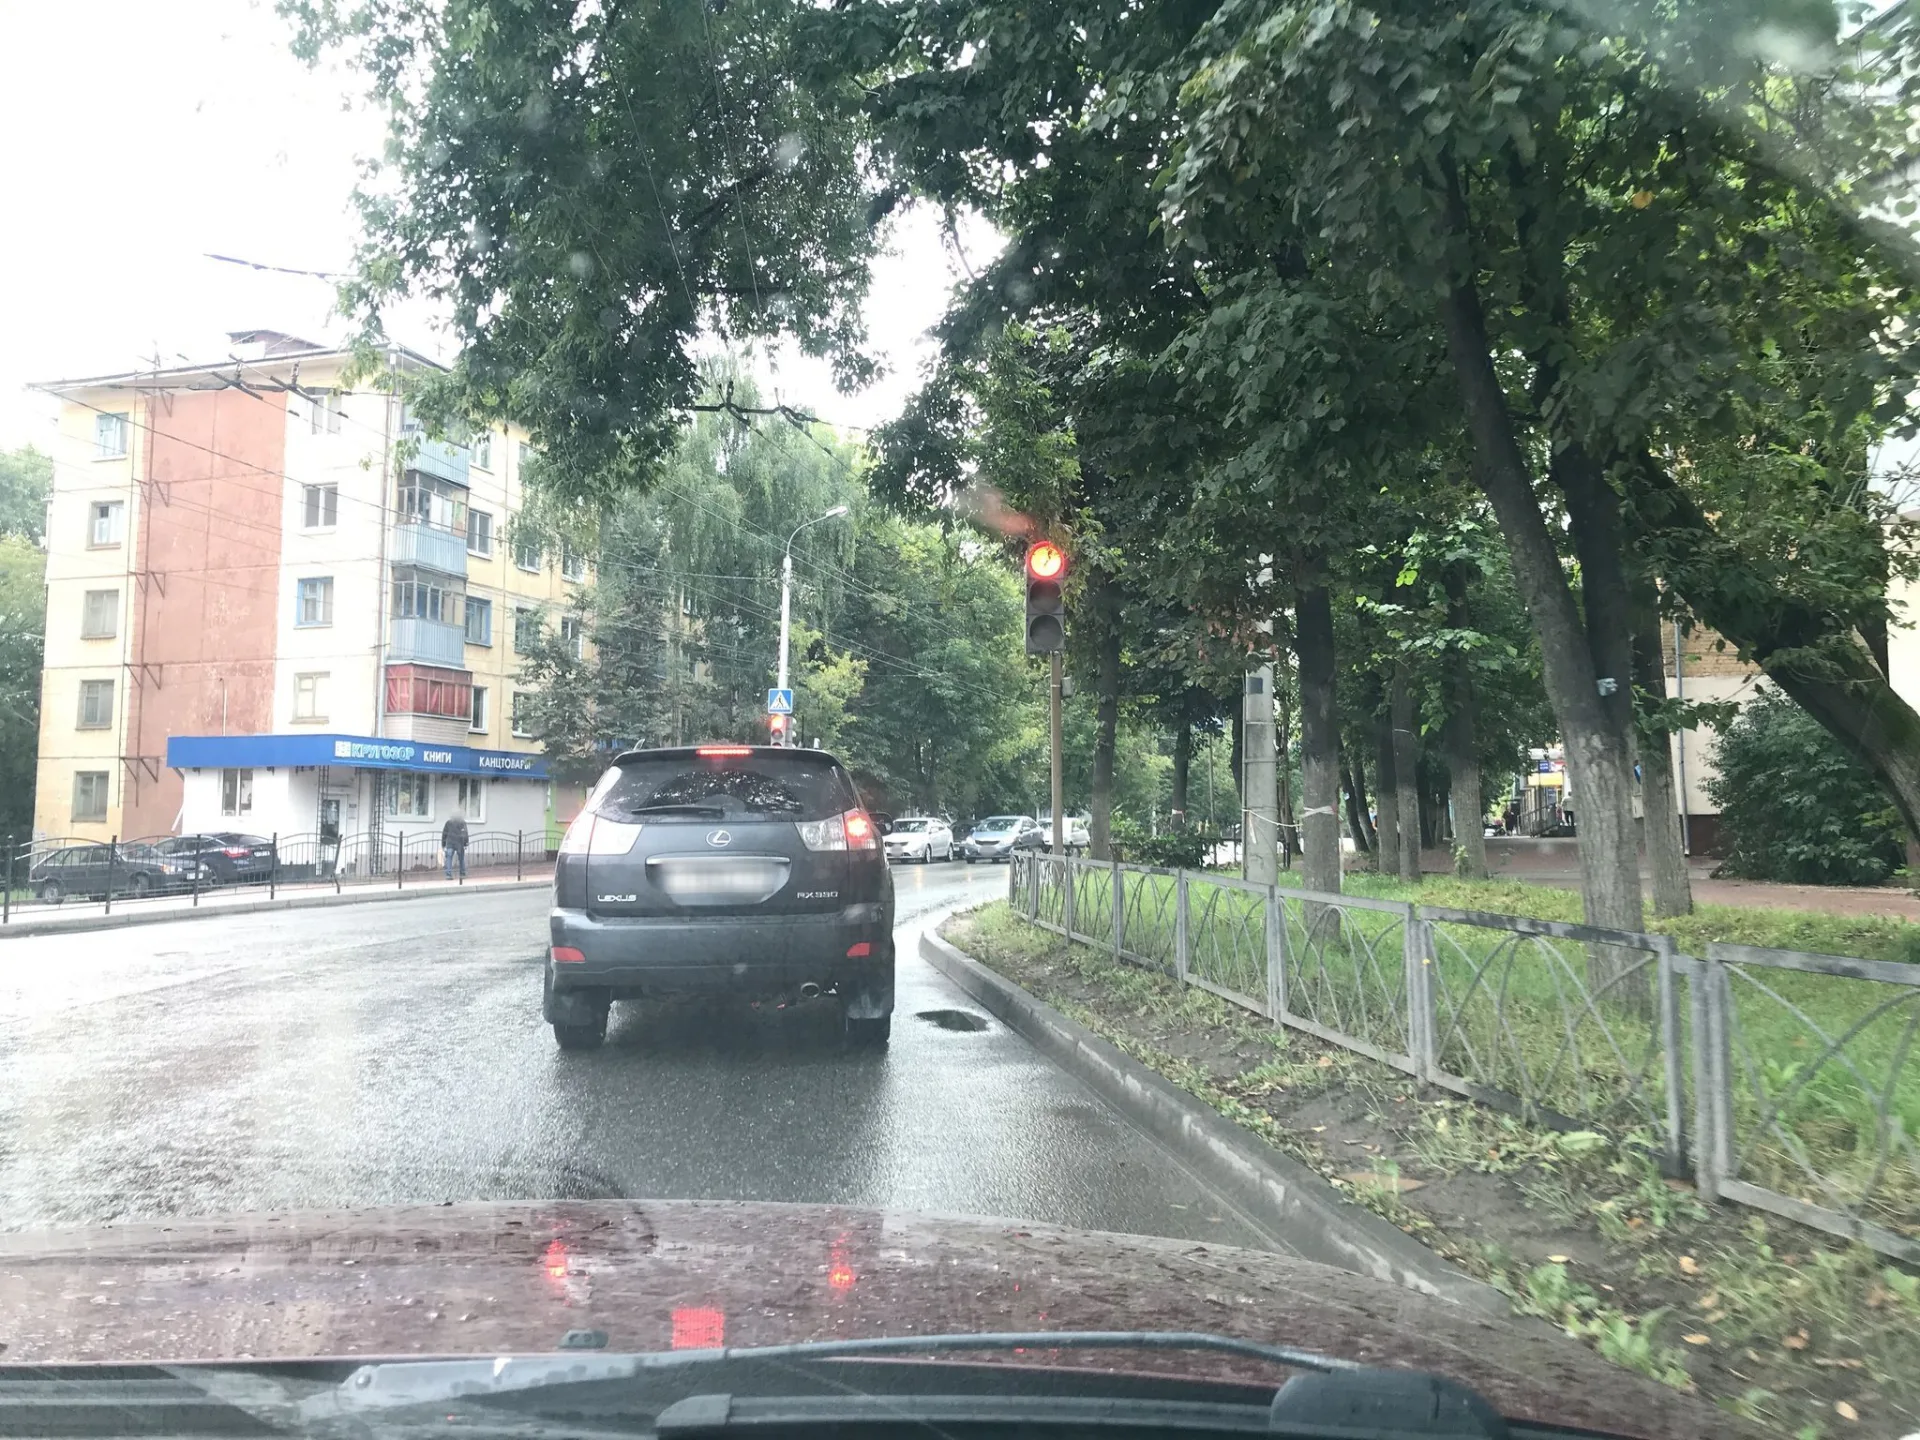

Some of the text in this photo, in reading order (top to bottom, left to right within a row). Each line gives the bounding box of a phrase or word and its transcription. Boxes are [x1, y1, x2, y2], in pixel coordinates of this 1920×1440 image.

[352, 743, 415, 761] КРУГОЗОР
[423, 750, 452, 764] КНИГИ
[597, 894, 637, 902] LEXUS
